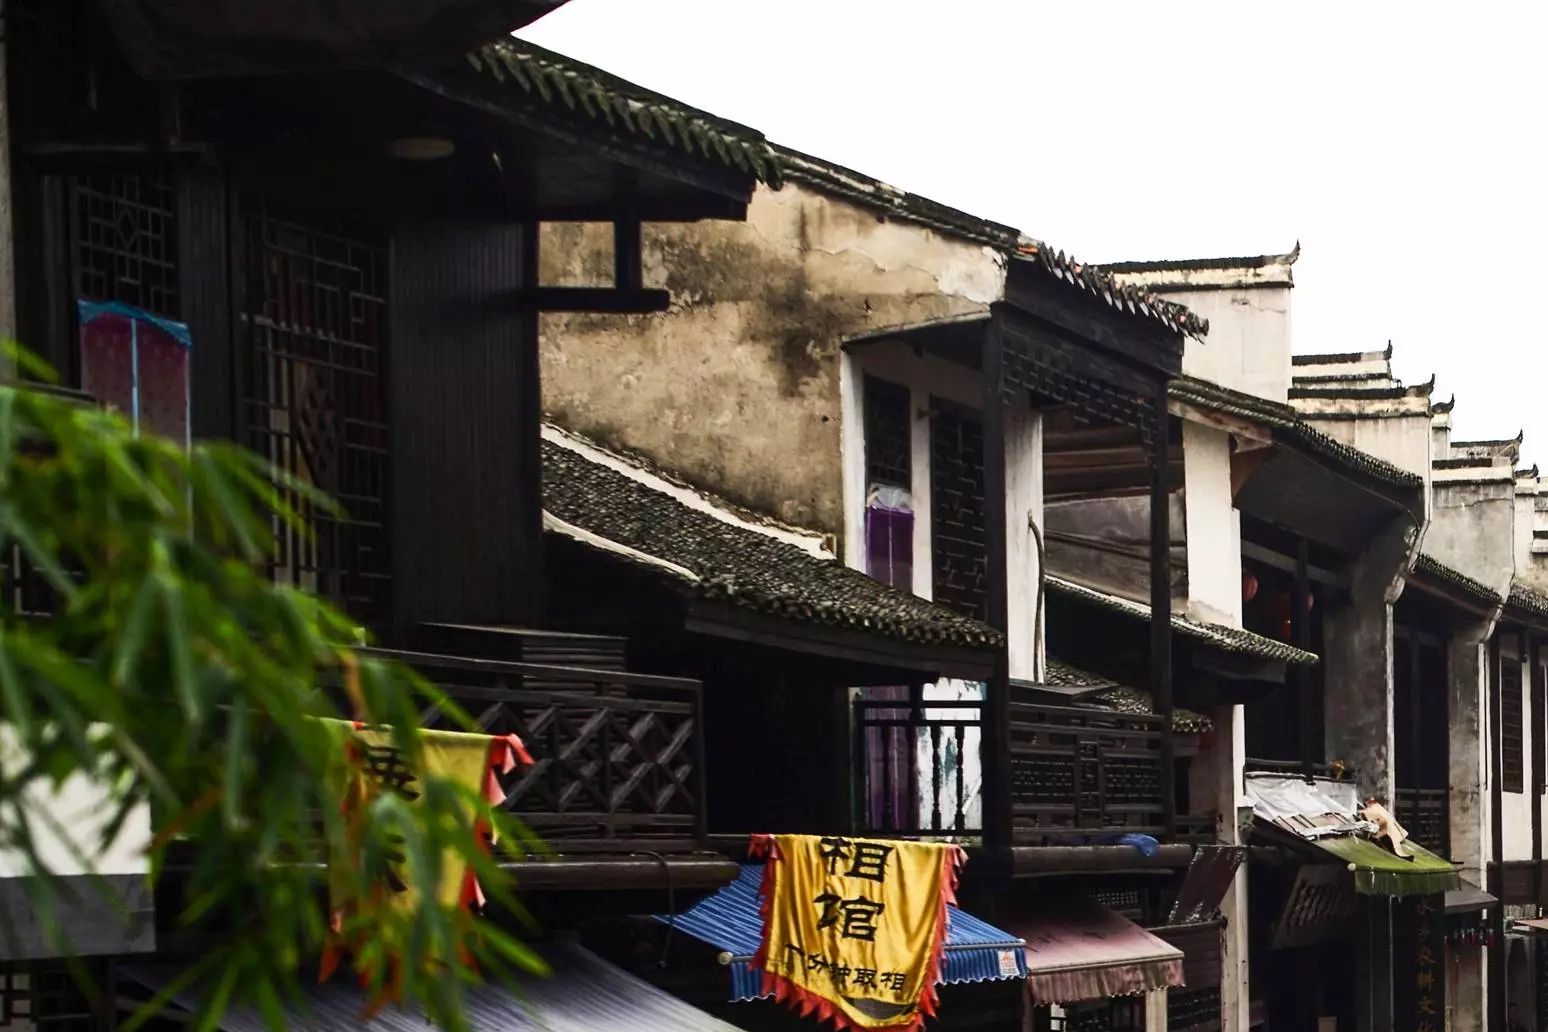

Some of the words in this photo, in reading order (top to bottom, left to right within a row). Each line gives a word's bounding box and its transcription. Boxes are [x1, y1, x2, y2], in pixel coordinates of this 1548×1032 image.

[813, 836, 895, 942] 相馆
[786, 943, 906, 994] 一分钟取相
